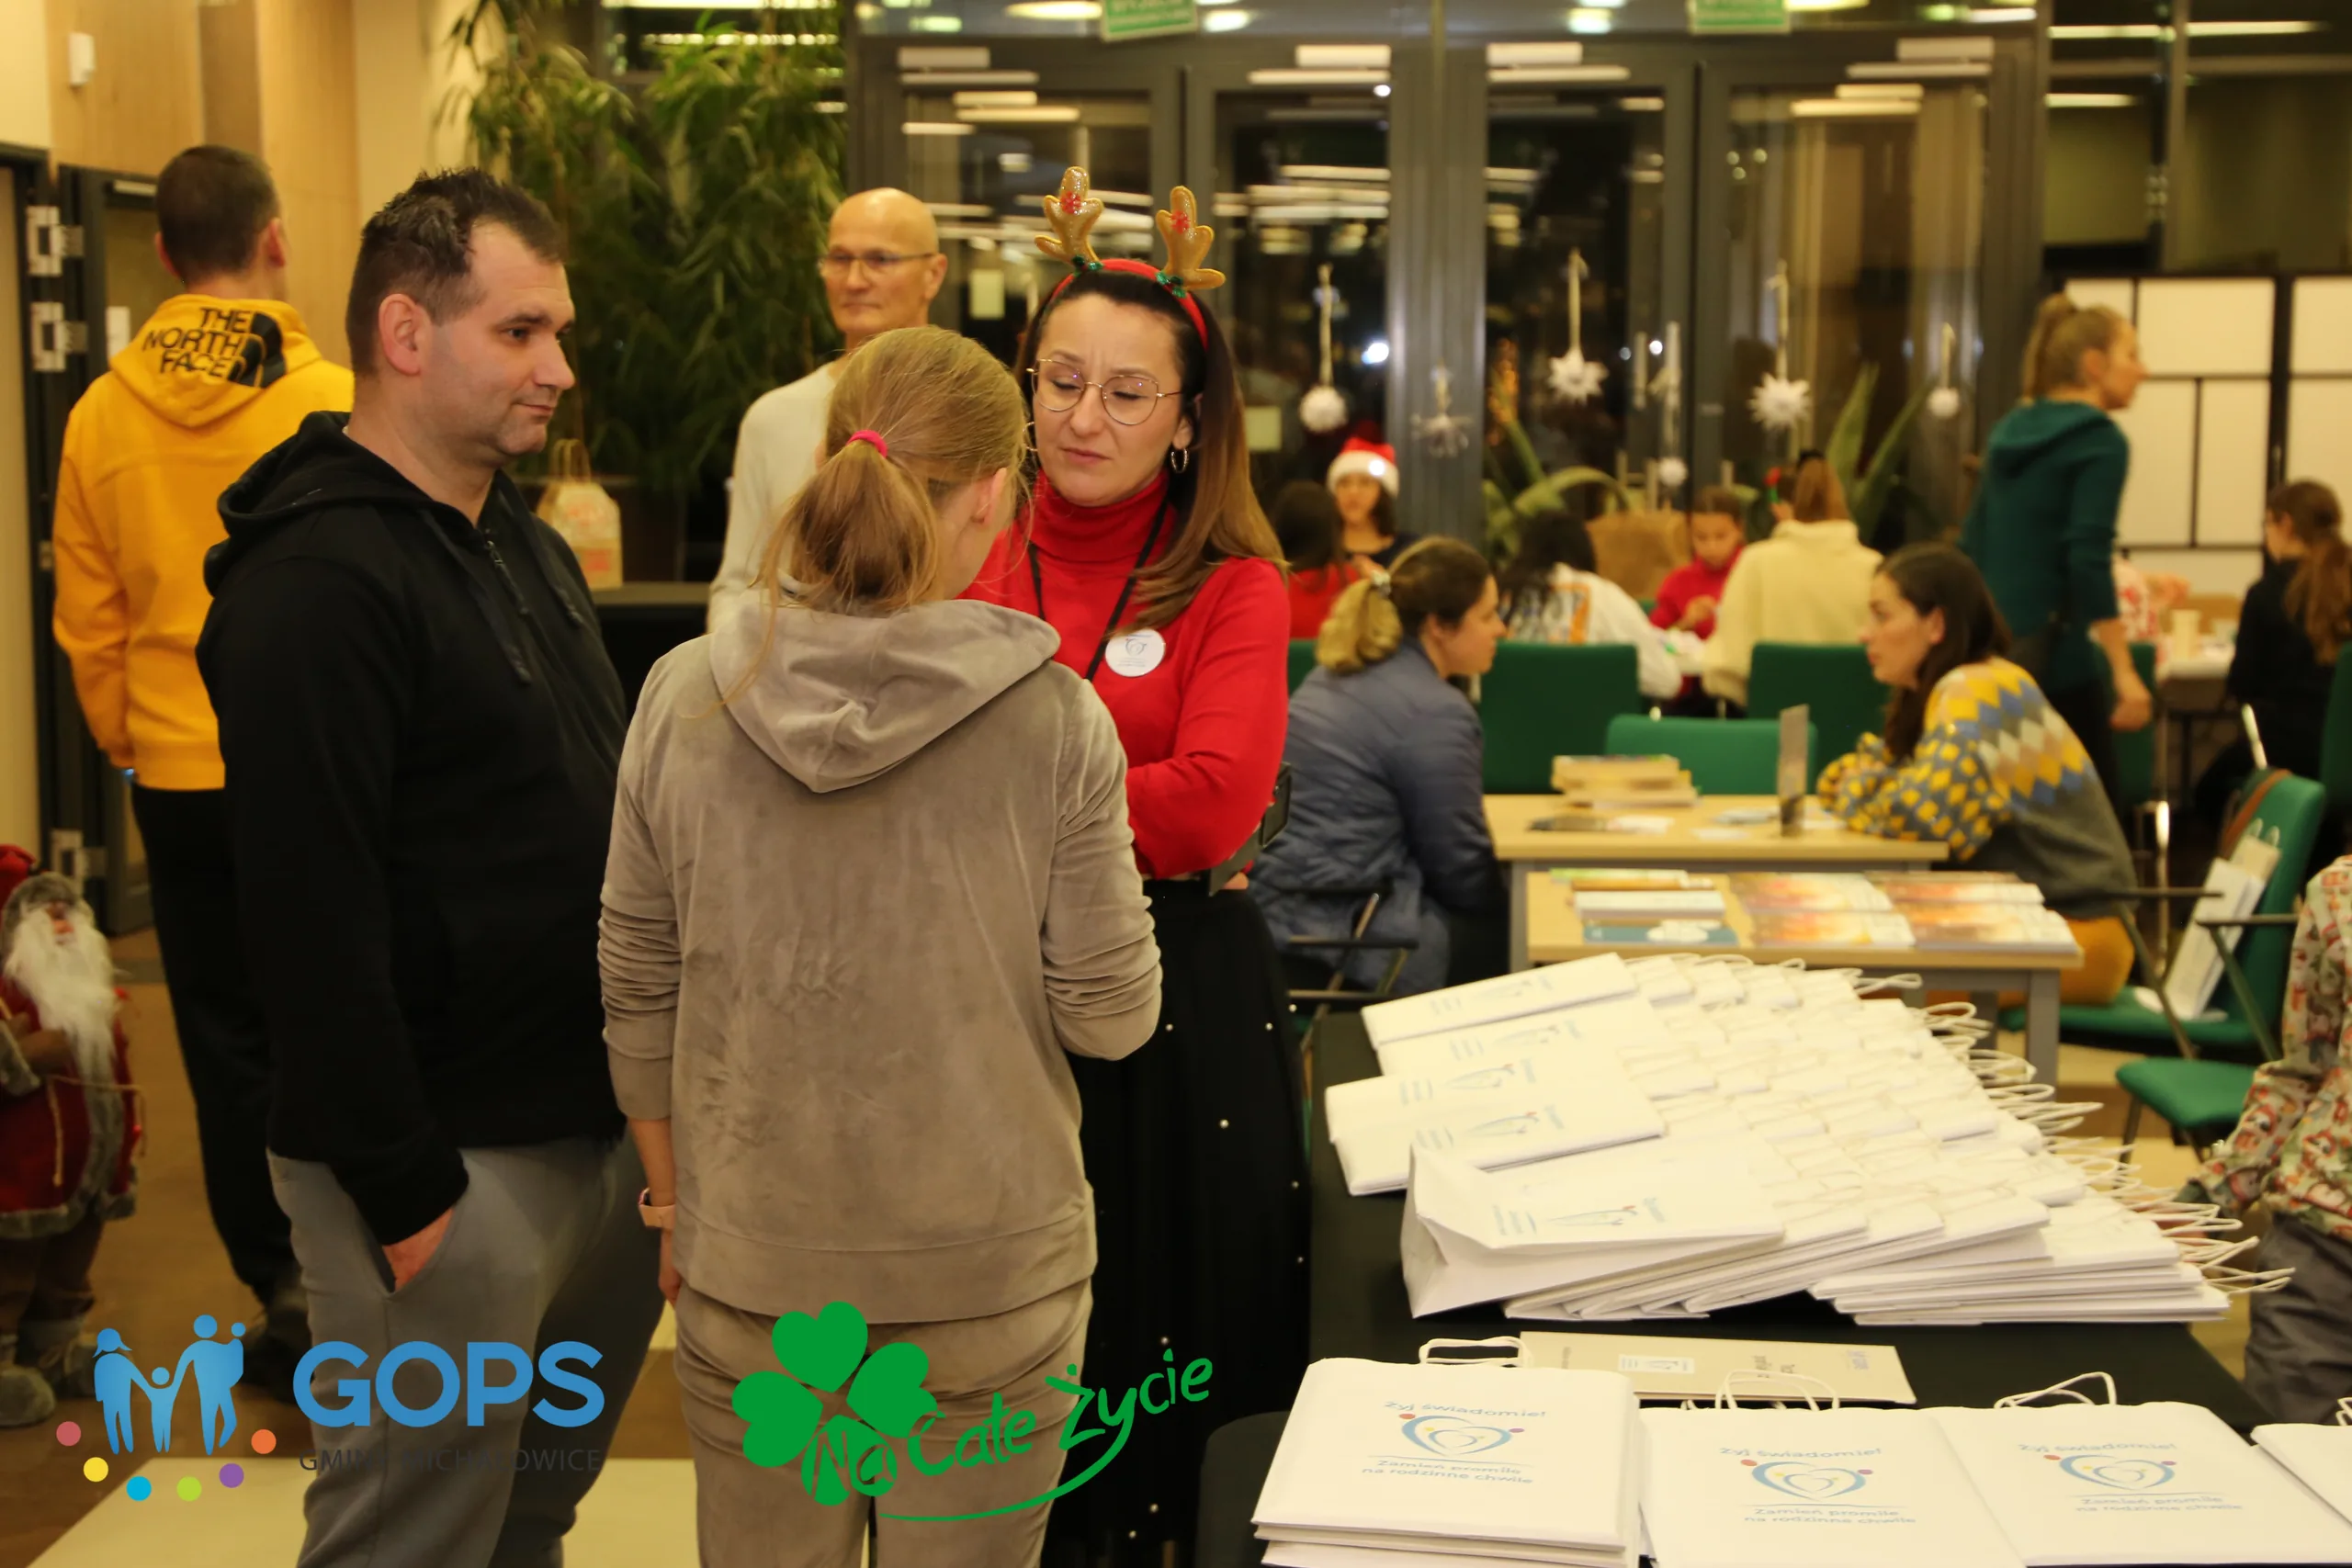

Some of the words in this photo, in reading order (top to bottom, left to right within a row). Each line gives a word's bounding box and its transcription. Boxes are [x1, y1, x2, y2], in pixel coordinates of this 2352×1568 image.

[199, 307, 251, 333] THE
[142, 327, 244, 356] NORTH
[160, 349, 232, 378] FACE
[1389, 1467, 1471, 1481] rodzinne
[1475, 1473, 1534, 1484] chwile
